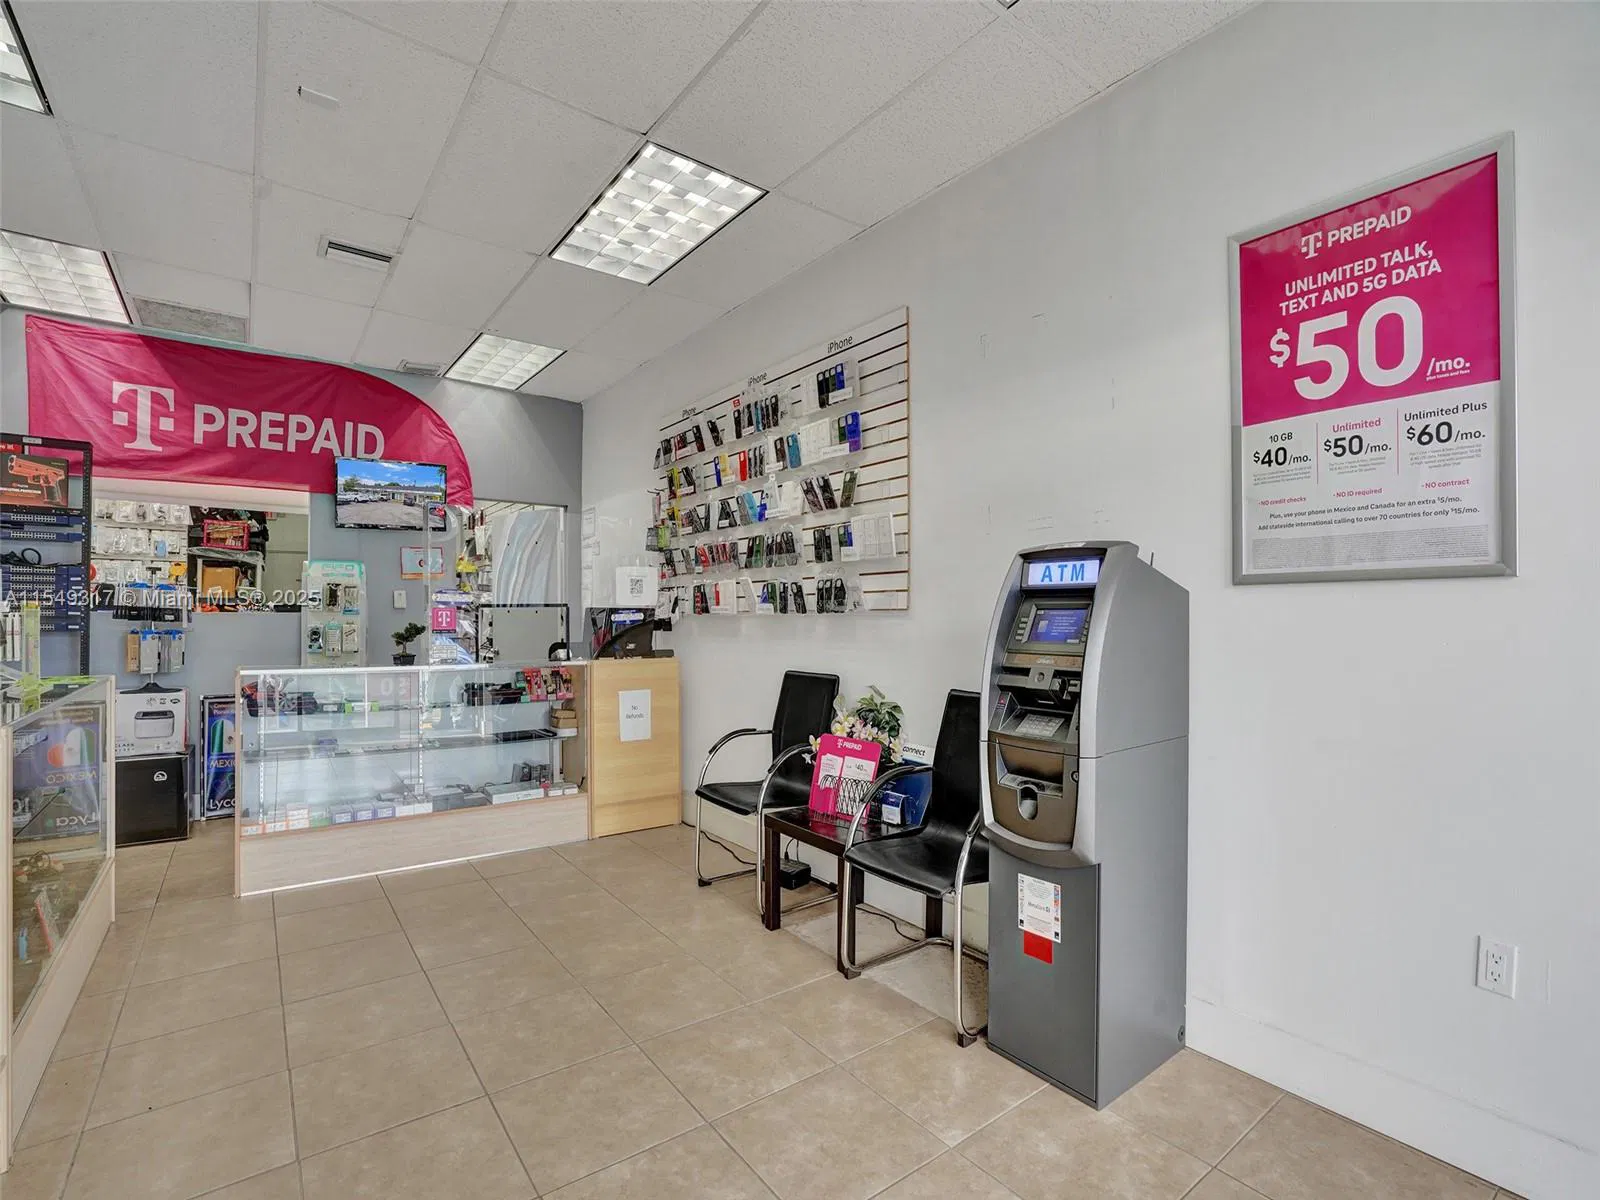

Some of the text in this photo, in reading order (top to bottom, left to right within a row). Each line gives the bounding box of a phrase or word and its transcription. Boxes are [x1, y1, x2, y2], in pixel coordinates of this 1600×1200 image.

[1327, 205, 1412, 248] PREPAID
[1285, 240, 1433, 296] UNLIMITED TALK,
[1279, 258, 1442, 316] TEXT AND 5G DATA
[827, 335, 853, 354] iPhone
[747, 371, 768, 386] iPhone
[112, 380, 385, 460] T PREPAID
[1404, 402, 1488, 422] Unlimited Plus
[1332, 417, 1381, 433] Unlimited
[1406, 421, 1486, 446] $60/mo.
[1269, 431, 1293, 443] 10 GB
[1323, 434, 1392, 458] $50/mo.
[1253, 446, 1311, 467] $40/mo.
[1354, 487, 1382, 497] required
[1437, 478, 1470, 488] contract
[1269, 497, 1286, 506] credit
[1286, 495, 1307, 504] checks
[1307, 508, 1326, 517] phone
[1370, 501, 1395, 510] Canada
[1417, 498, 1436, 506] extra
[1269, 522, 1295, 530] stateside
[1295, 519, 1333, 528] international
[1333, 517, 1355, 525] calling
[1388, 511, 1421, 520] countries
[1433, 509, 1450, 517] only
[1040, 563, 1085, 583] ATM
[902, 745, 926, 757] connect
[210, 759, 235, 769] MEXI
